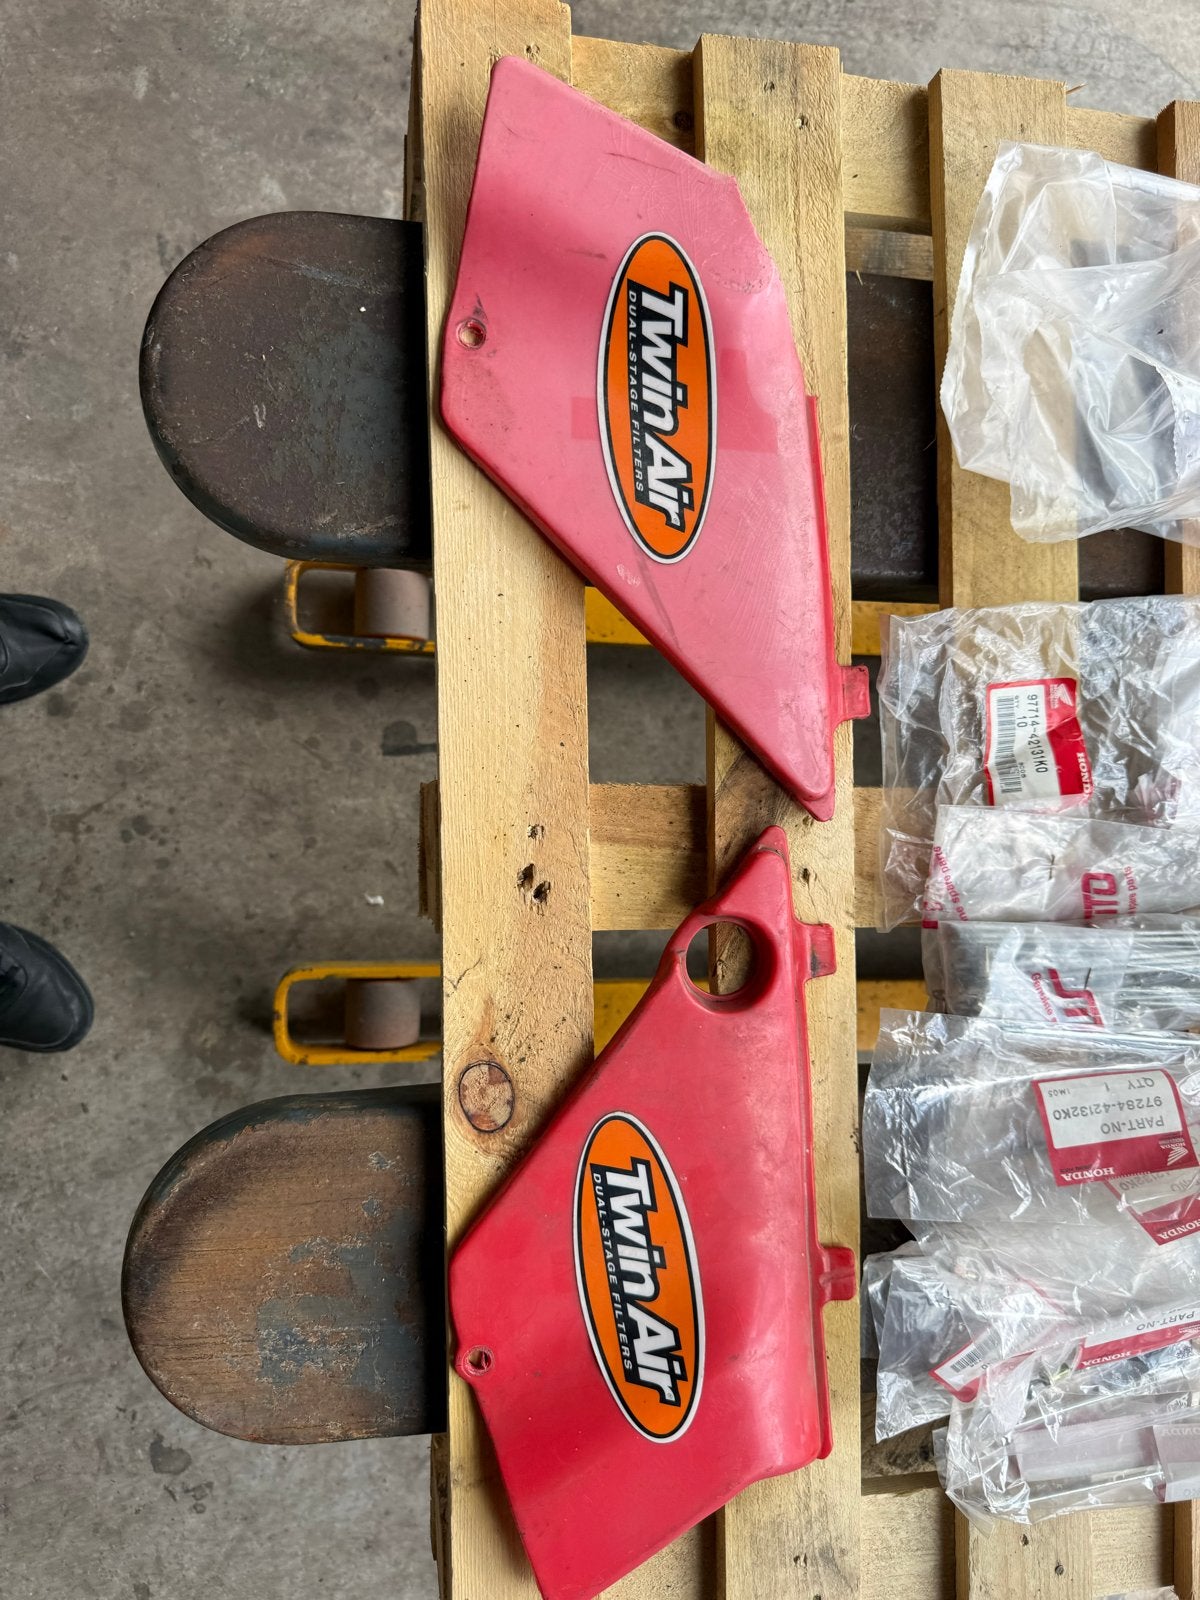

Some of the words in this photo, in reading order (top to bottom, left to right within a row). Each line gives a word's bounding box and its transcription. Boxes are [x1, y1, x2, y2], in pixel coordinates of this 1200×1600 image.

[628, 290, 640, 411] DUAL-STAGE
[642, 289, 684, 433] Twin
[631, 419, 644, 492] FILTERS
[1016, 715, 1028, 728] 10
[1126, 1077, 1155, 1090] QTY
[1100, 1115, 1165, 1135] PART-NO
[1060, 1166, 1115, 1182] HONDA
[606, 1163, 661, 1298] Twin
[593, 1173, 618, 1285] DUAL-STAGE
[612, 1293, 633, 1370] FILTERS
[1136, 1311, 1196, 1332] PART-NO
[1081, 1350, 1132, 1367] HONDA
